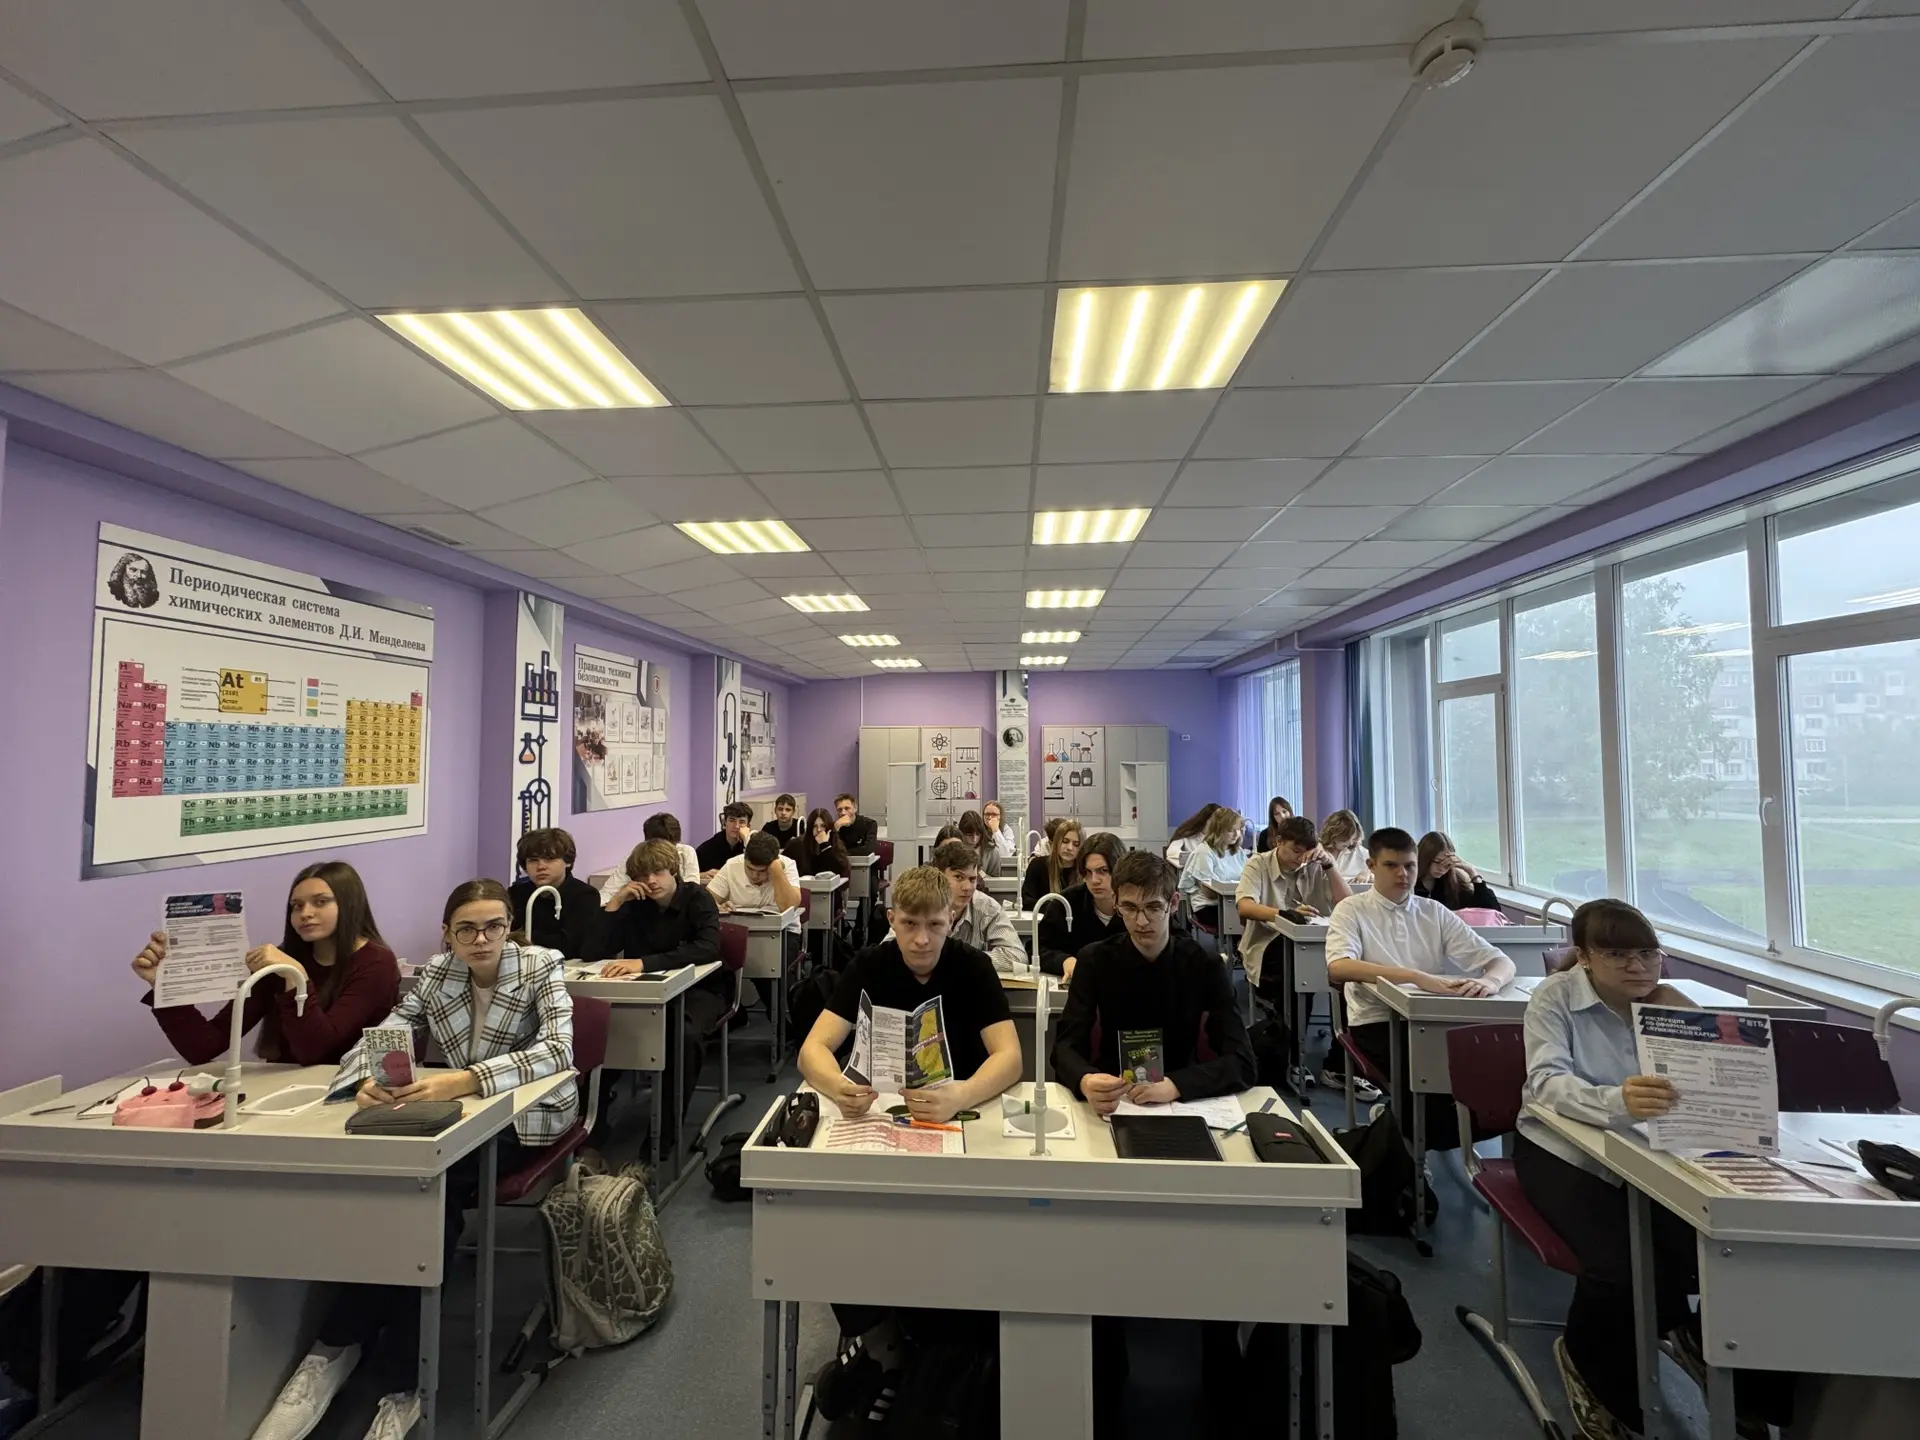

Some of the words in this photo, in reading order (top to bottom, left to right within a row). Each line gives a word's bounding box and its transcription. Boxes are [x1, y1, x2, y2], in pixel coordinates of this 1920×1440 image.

[169, 567, 286, 607] Периодическая
[292, 599, 340, 618] система
[168, 594, 263, 622] химических
[268, 613, 335, 635] элементов
[339, 623, 365, 641] Д.И.
[369, 629, 426, 652] Менделеева
[578, 657, 606, 674] Правила
[608, 667, 632, 680] техники
[221, 672, 244, 688] At
[577, 671, 620, 687] безопасности
[118, 701, 132, 709] Na
[143, 702, 157, 711] Mg
[166, 722, 176, 730] Sc
[141, 740, 152, 748] Sr
[115, 759, 127, 767] Cs
[140, 759, 153, 767] Ba
[114, 779, 125, 787] Fr
[184, 800, 196, 808] Ce
[183, 818, 195, 826] Th
[1746, 1019, 1764, 1027] ВТБ
